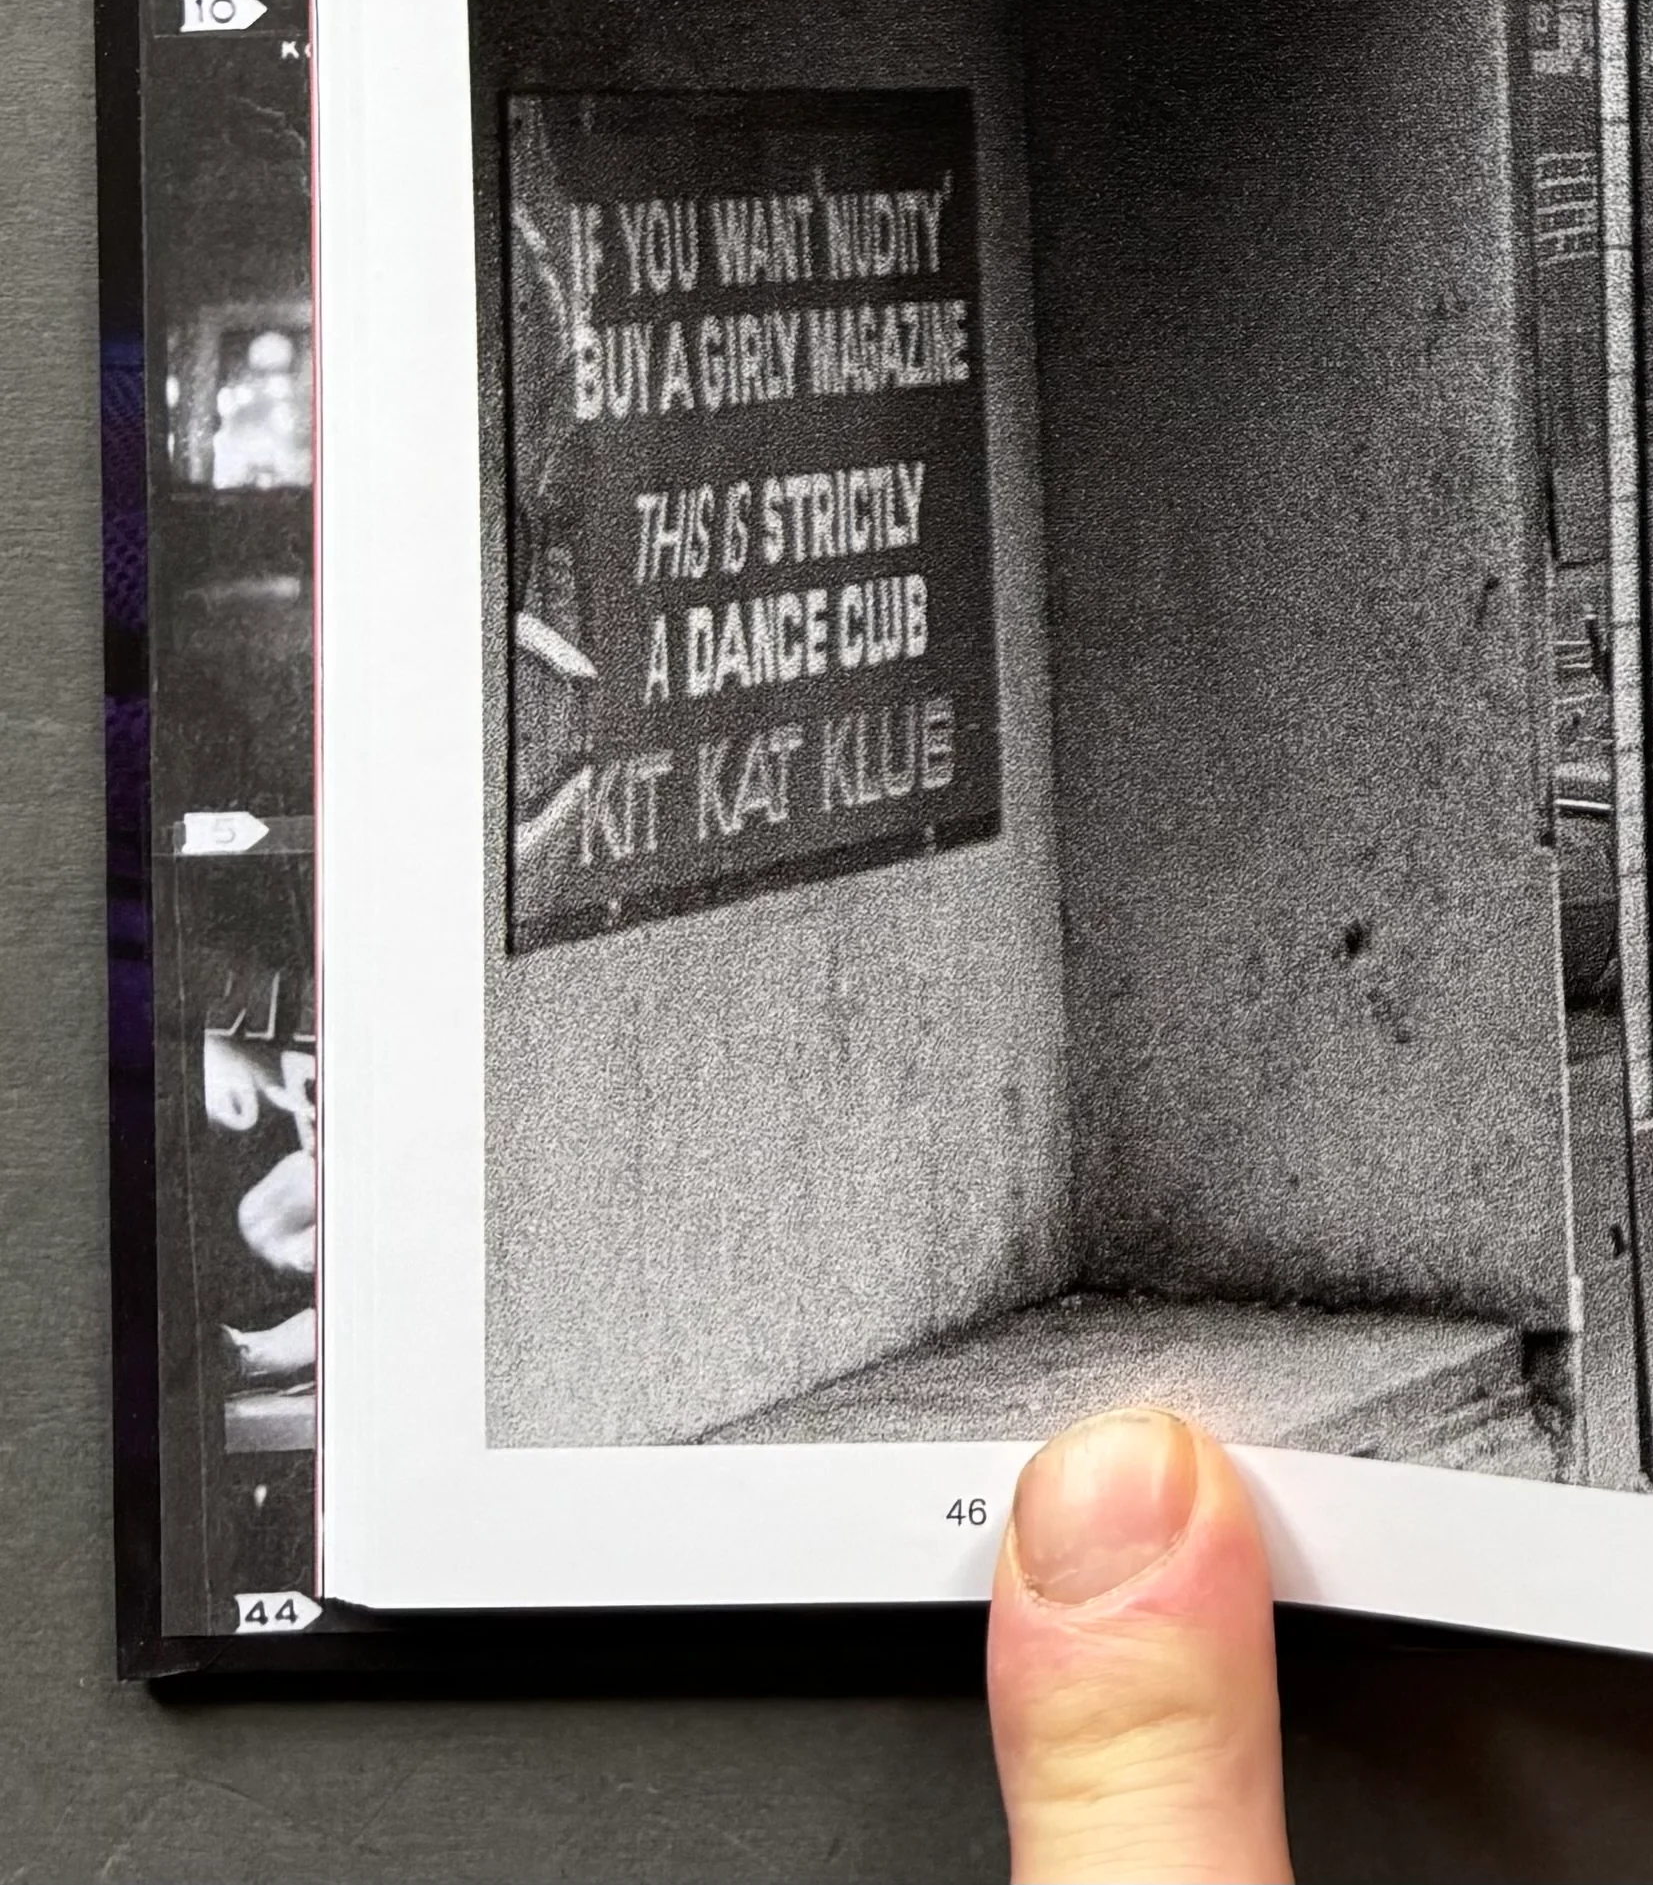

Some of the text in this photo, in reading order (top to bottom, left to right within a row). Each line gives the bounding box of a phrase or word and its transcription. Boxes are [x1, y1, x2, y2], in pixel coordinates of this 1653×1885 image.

[619, 199, 700, 296] YOU
[711, 194, 814, 287] WANT
[573, 299, 970, 421] BUY A GIRLY MAGAZINE
[635, 461, 925, 586] THIS IS STRICTLY
[643, 573, 929, 704] A DANCE CLUB
[578, 749, 674, 868] KIT
[696, 722, 805, 843] KAT
[945, 1498, 988, 1527] 46
[245, 1598, 298, 1625] 44
